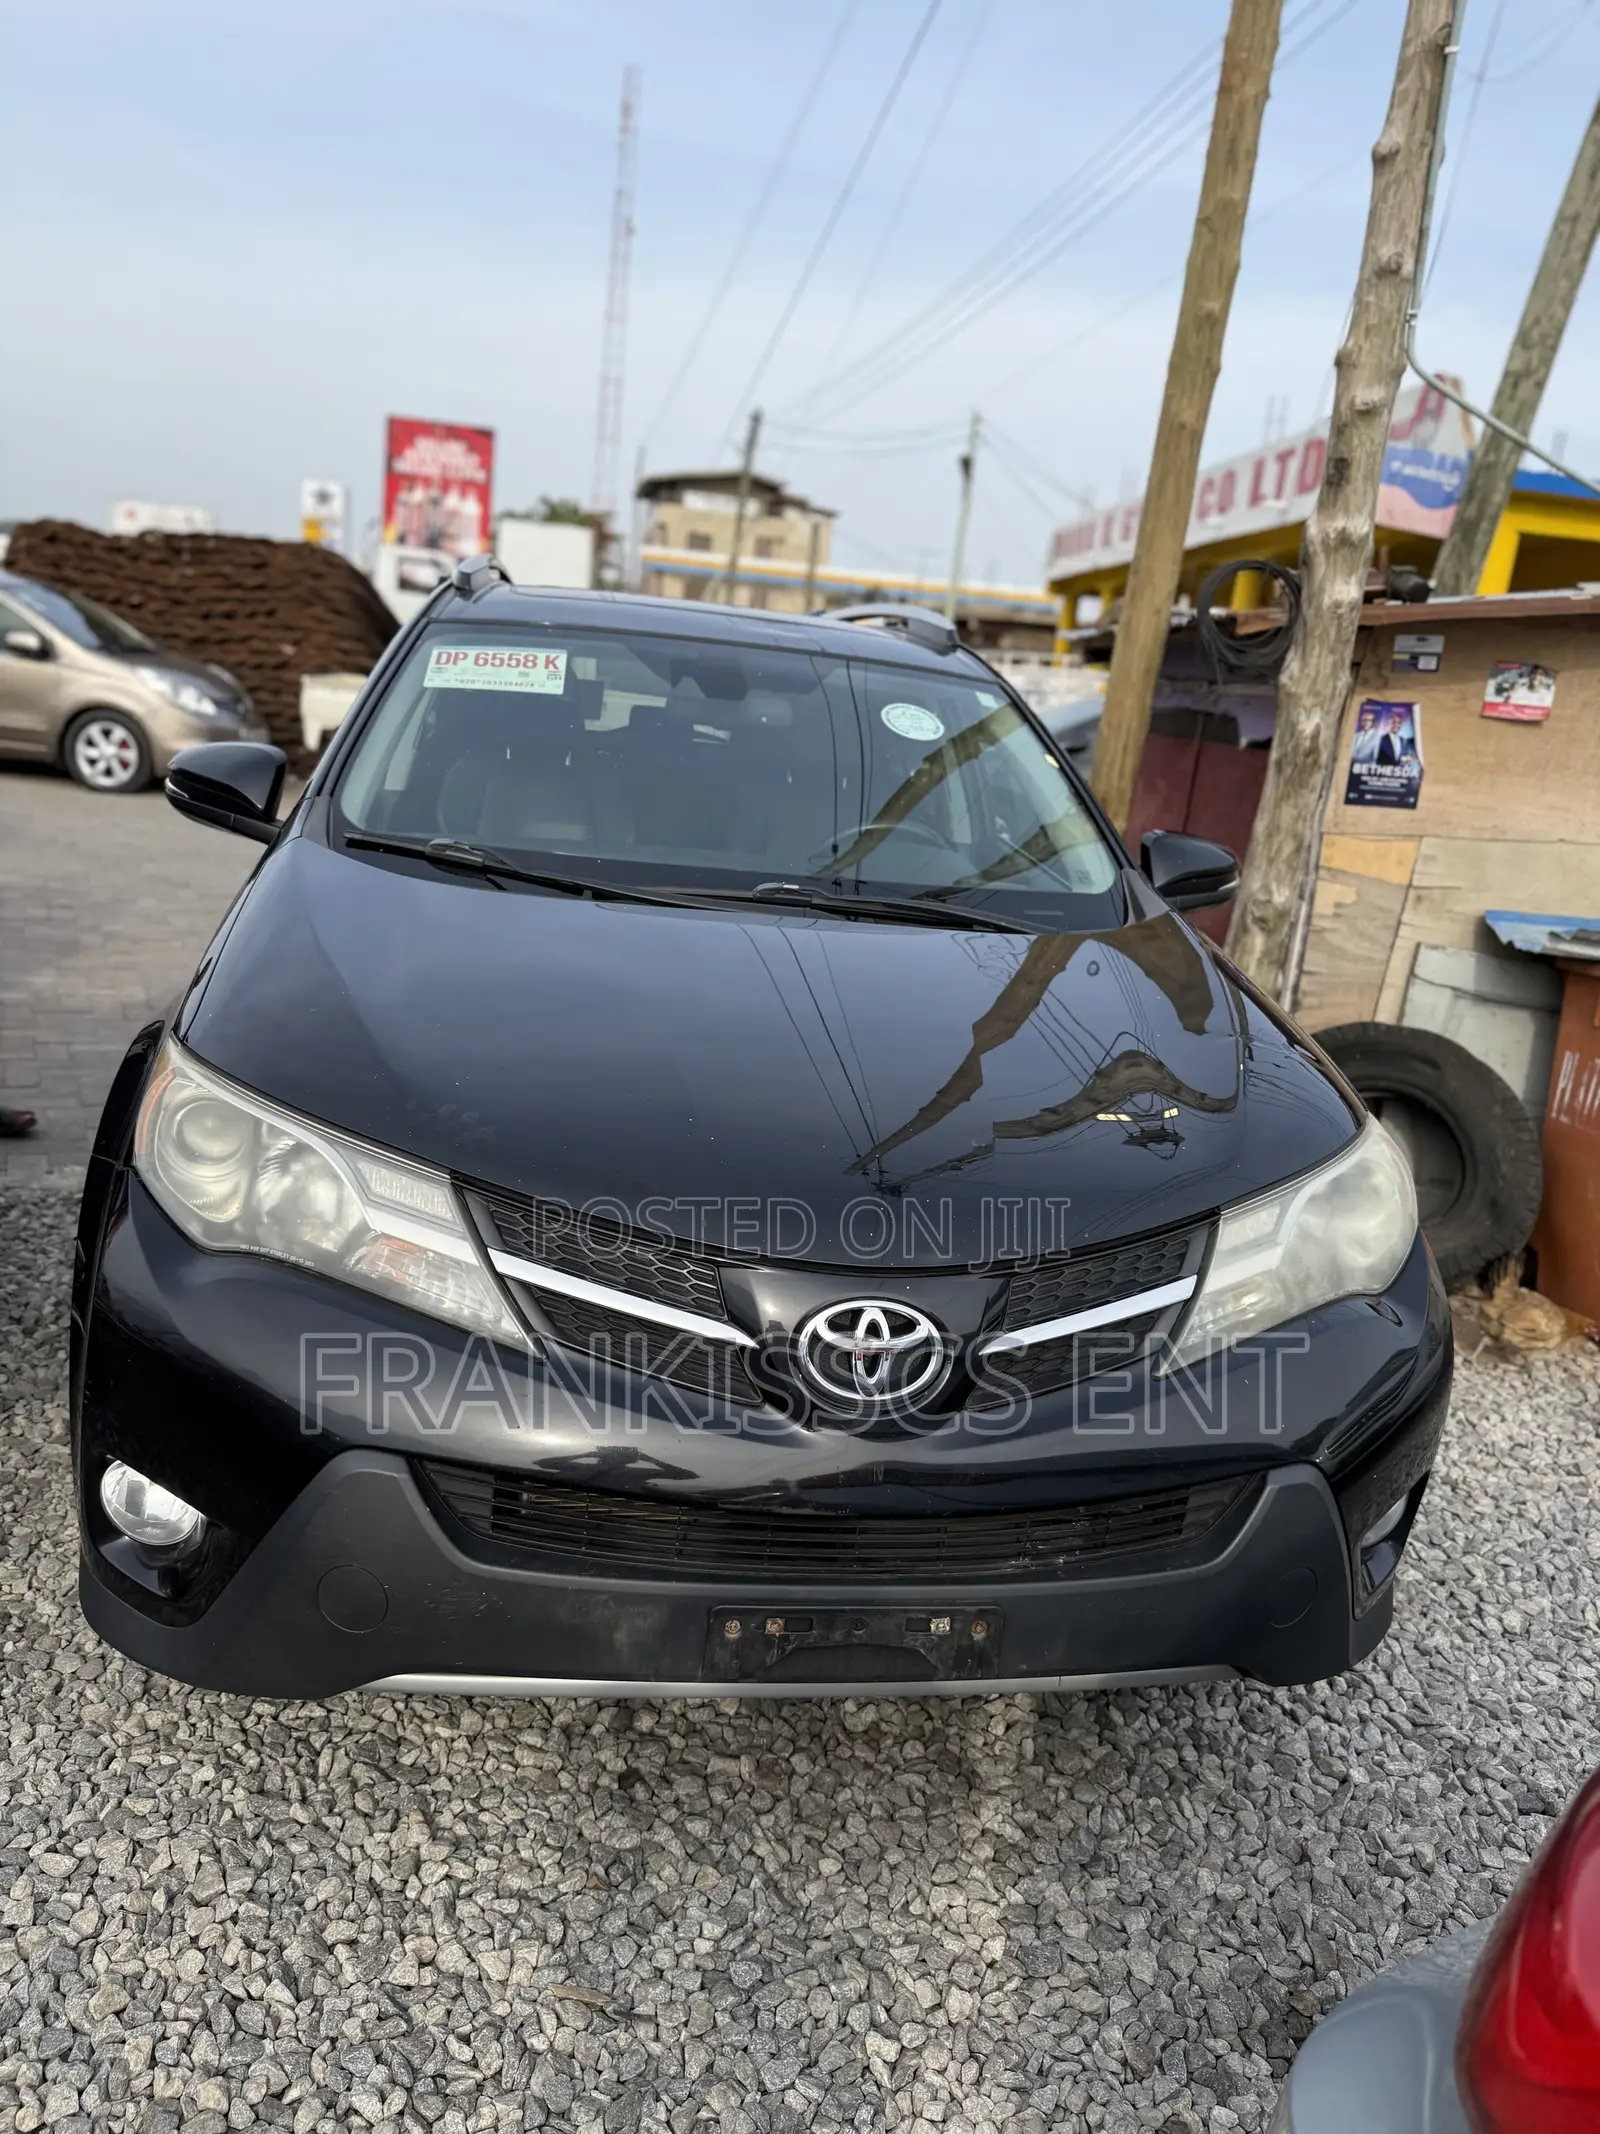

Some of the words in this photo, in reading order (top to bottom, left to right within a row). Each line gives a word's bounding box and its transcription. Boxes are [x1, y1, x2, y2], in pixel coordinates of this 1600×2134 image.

[1248, 437, 1326, 510] LTD
[434, 651, 469, 666] DP
[473, 651, 539, 670] 6558
[544, 654, 561, 671] K
